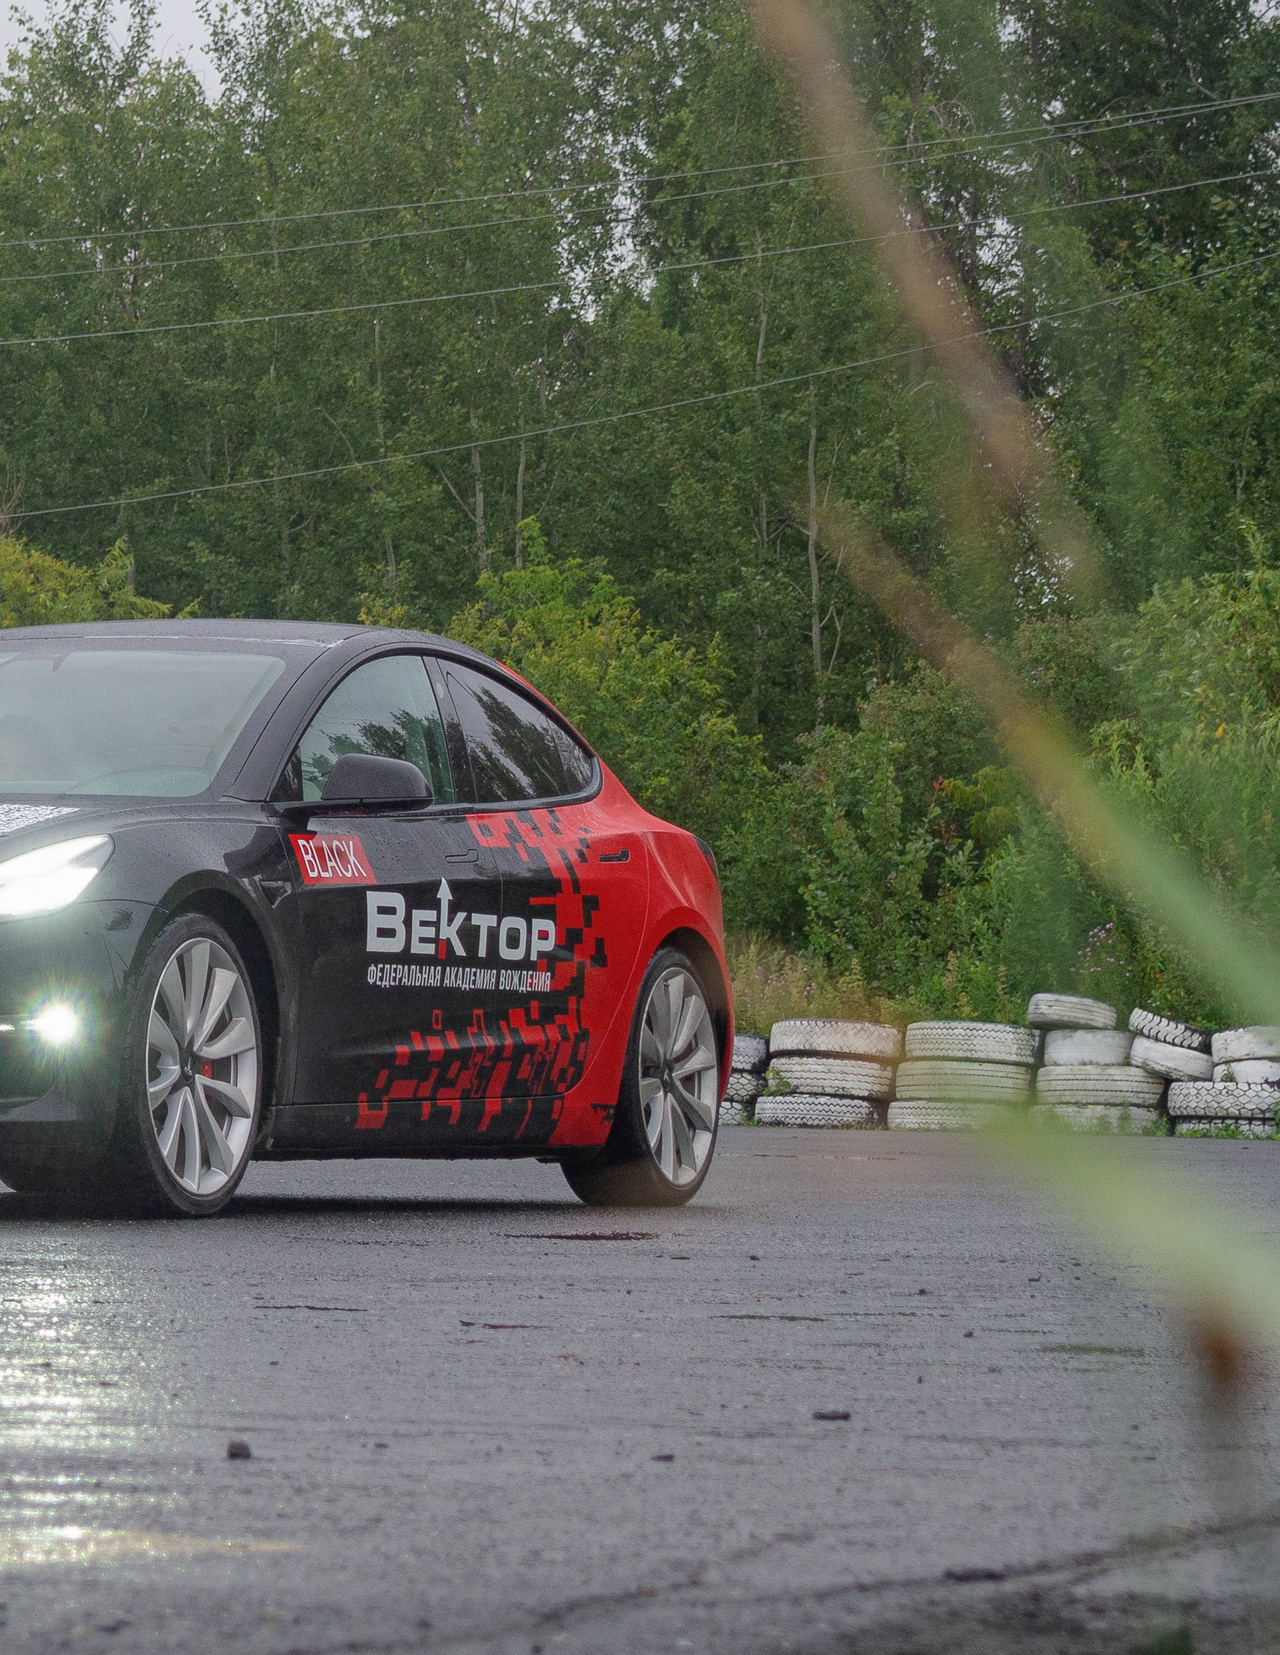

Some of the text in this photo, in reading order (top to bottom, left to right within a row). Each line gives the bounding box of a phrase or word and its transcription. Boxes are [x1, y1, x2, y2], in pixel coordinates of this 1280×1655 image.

[297, 839, 367, 877] BLACK
[367, 963, 552, 994] ФЕДЕРАЛЬНАЯ АКАДЕМИЯ ВОЖДЕНИЯ
